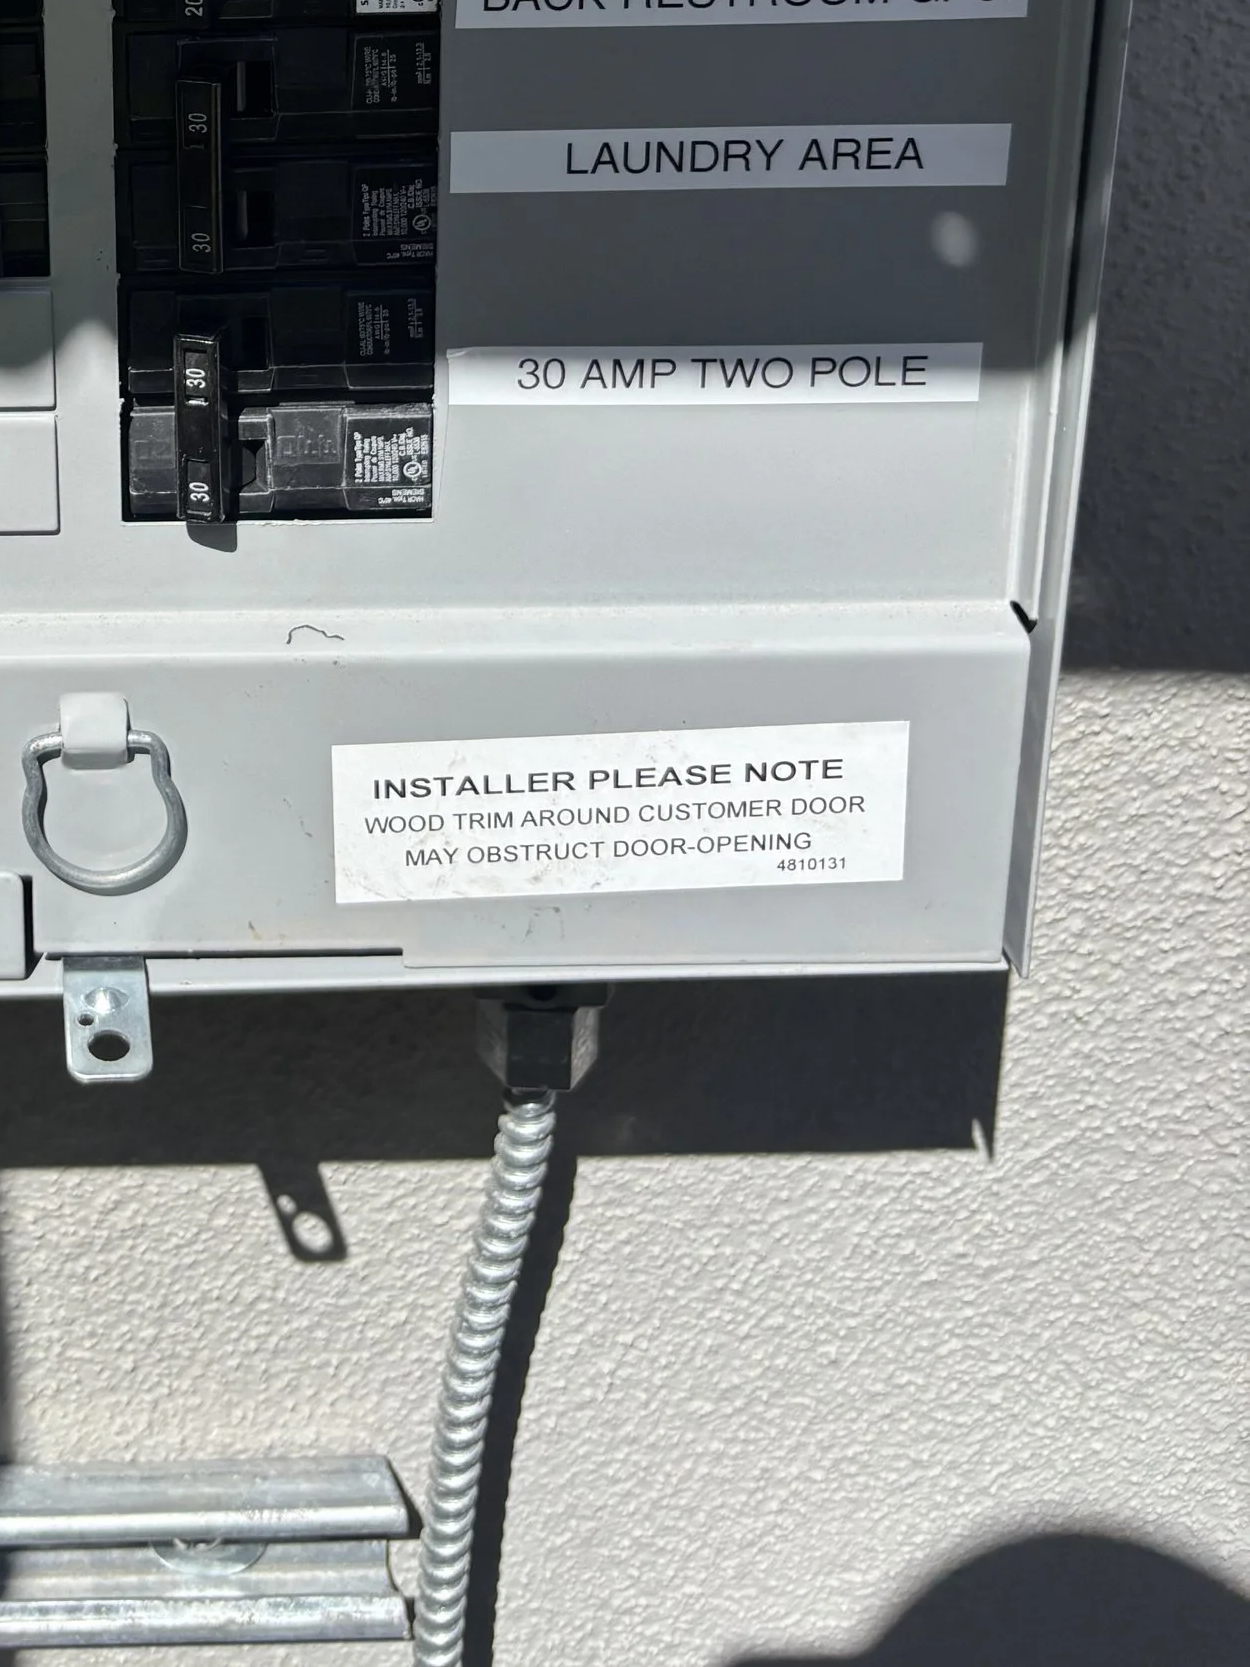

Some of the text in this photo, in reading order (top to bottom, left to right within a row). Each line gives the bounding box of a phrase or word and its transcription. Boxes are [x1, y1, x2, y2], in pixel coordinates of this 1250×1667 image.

[188, 113, 207, 133] 30
[567, 138, 923, 174] LAUNDRY AREA
[191, 233, 211, 252] 30
[186, 368, 206, 388] 30
[518, 356, 928, 389] 30 AMP TWO POLE
[189, 482, 210, 502] 30
[374, 759, 843, 799] INSTALLER PLEASE NOTE
[365, 796, 865, 834] WOOD TRIM AROUND CUSTOMER DOOR
[406, 832, 811, 866] MAY OBSTRUCT DOOR-OPENING
[776, 858, 847, 872] 4810131
